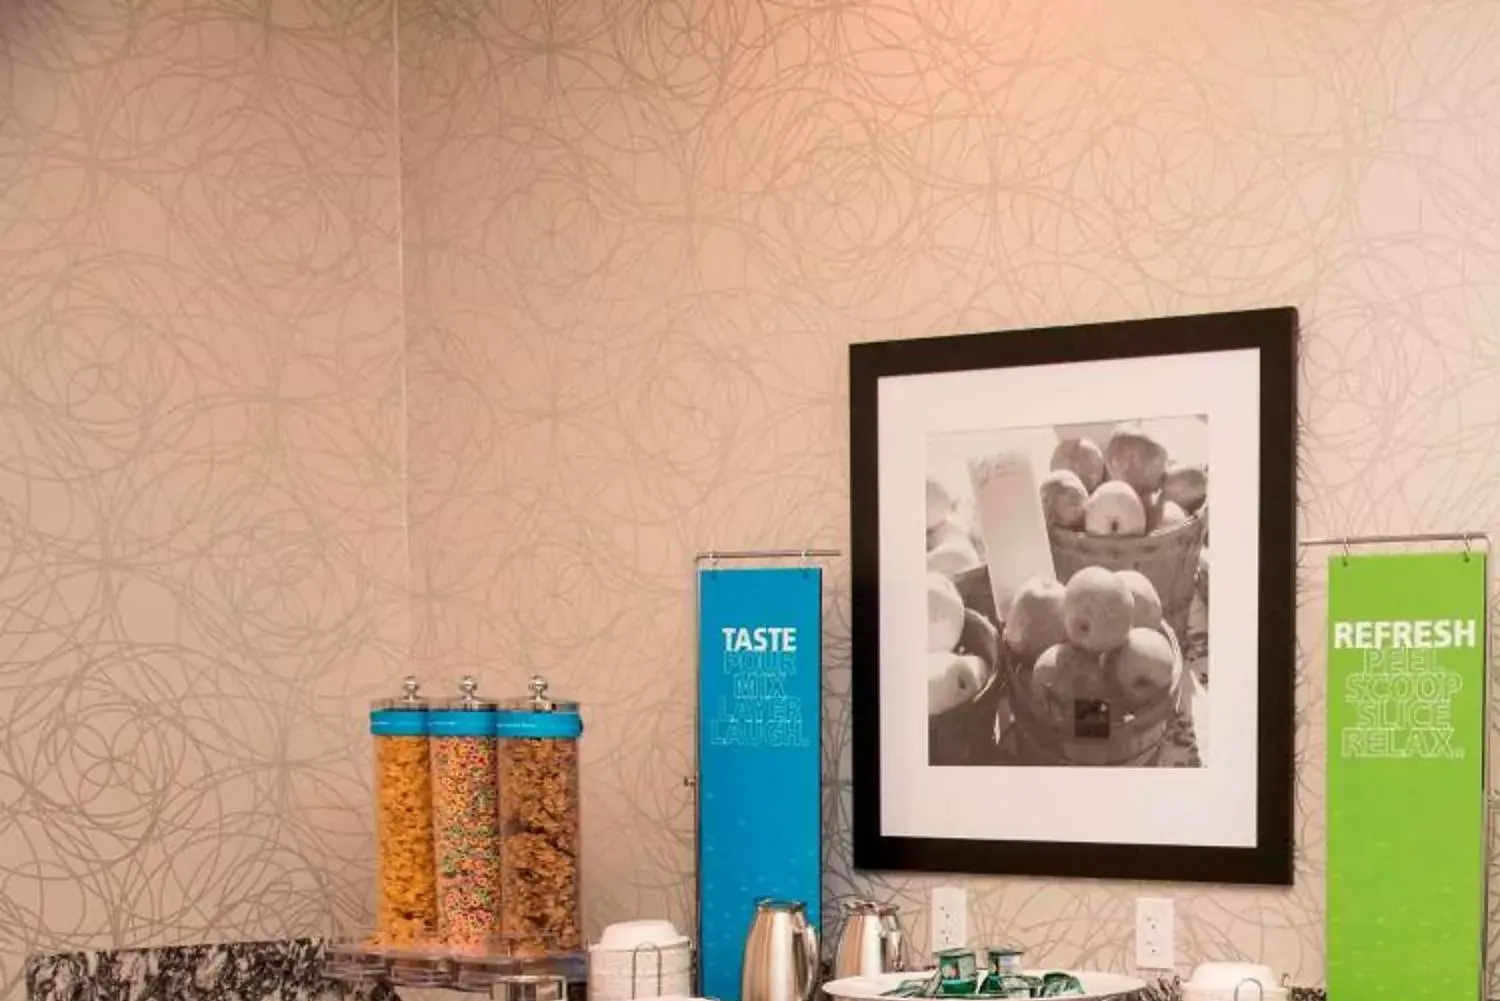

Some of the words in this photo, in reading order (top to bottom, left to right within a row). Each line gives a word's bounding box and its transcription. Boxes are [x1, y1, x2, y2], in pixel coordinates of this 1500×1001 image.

[722, 627, 797, 652] TASTE
[1334, 619, 1476, 649] REFRESH
[723, 651, 797, 675] POUR
[1363, 648, 1446, 674] PEEL
[733, 672, 786, 698] MIX
[1345, 672, 1463, 703] SCOOP
[718, 696, 801, 722] LAYER
[1356, 700, 1451, 729] SLICE
